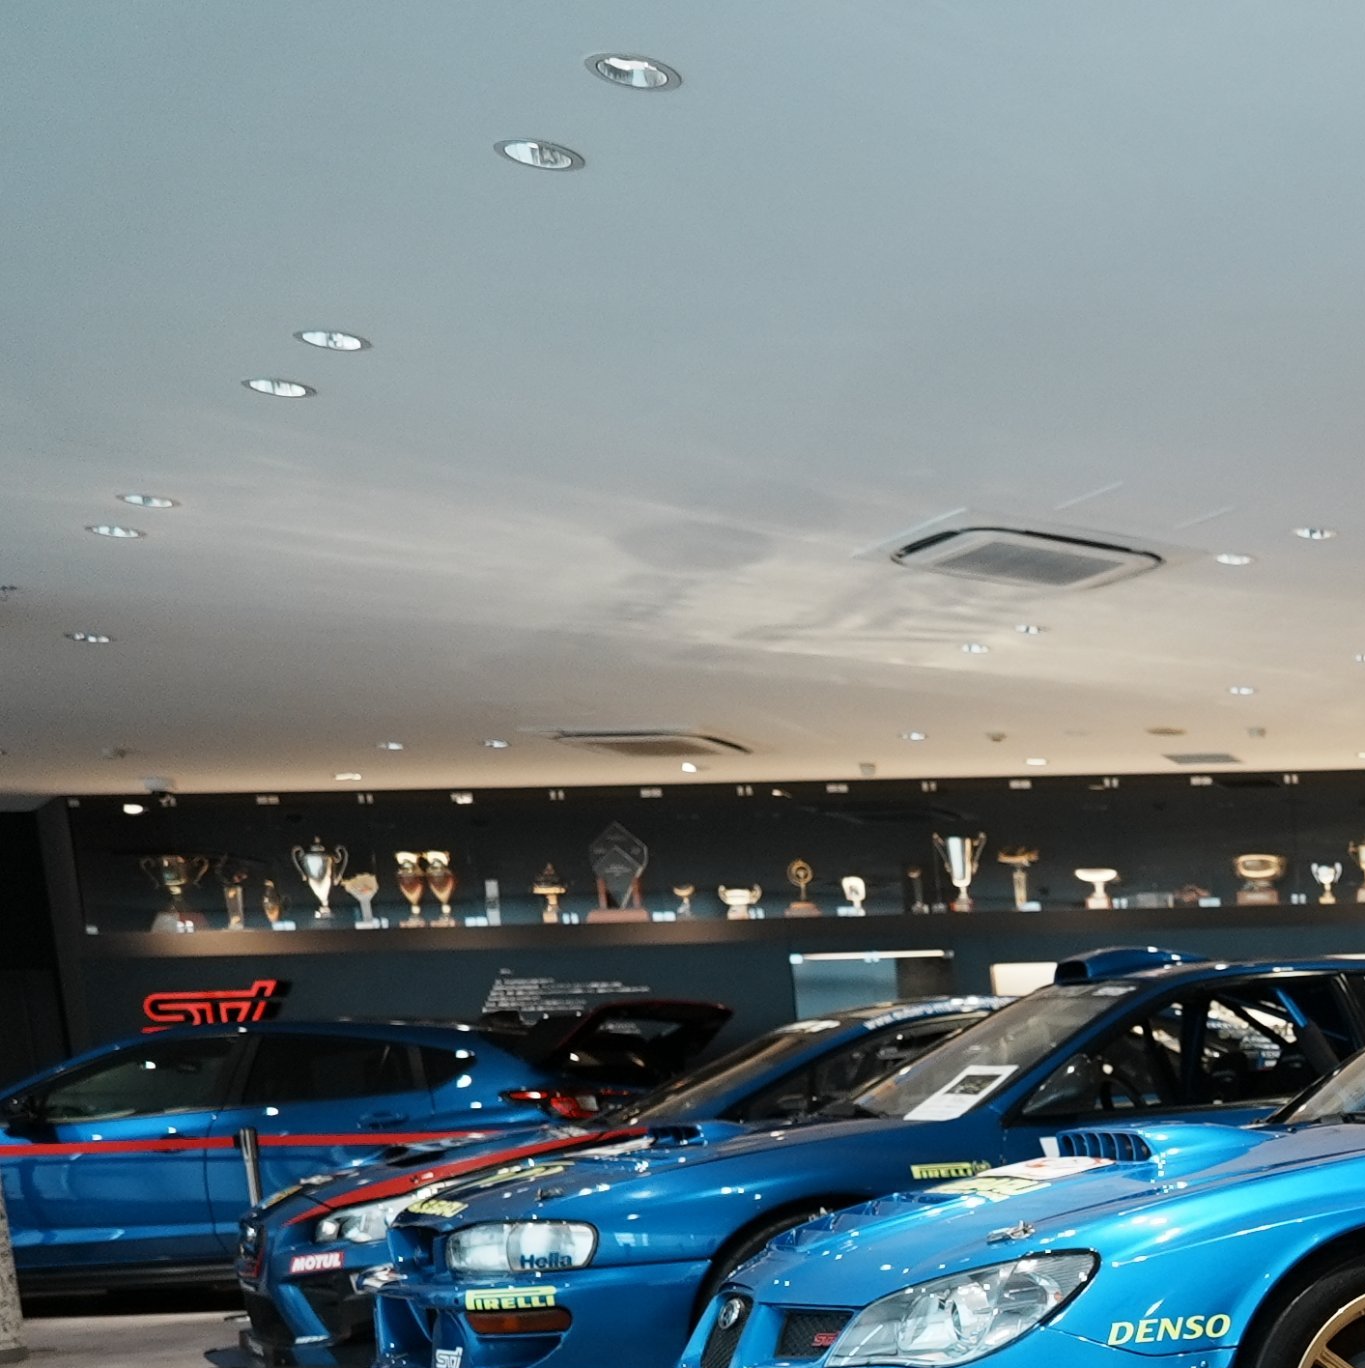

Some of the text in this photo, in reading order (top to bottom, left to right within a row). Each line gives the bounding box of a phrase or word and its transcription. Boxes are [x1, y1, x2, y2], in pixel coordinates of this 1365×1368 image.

[292, 1252, 342, 1272] MOTUL
[520, 1253, 572, 1269] Hella
[466, 1286, 558, 1311] PIRELLI
[1109, 1308, 1231, 1346] DENSO
